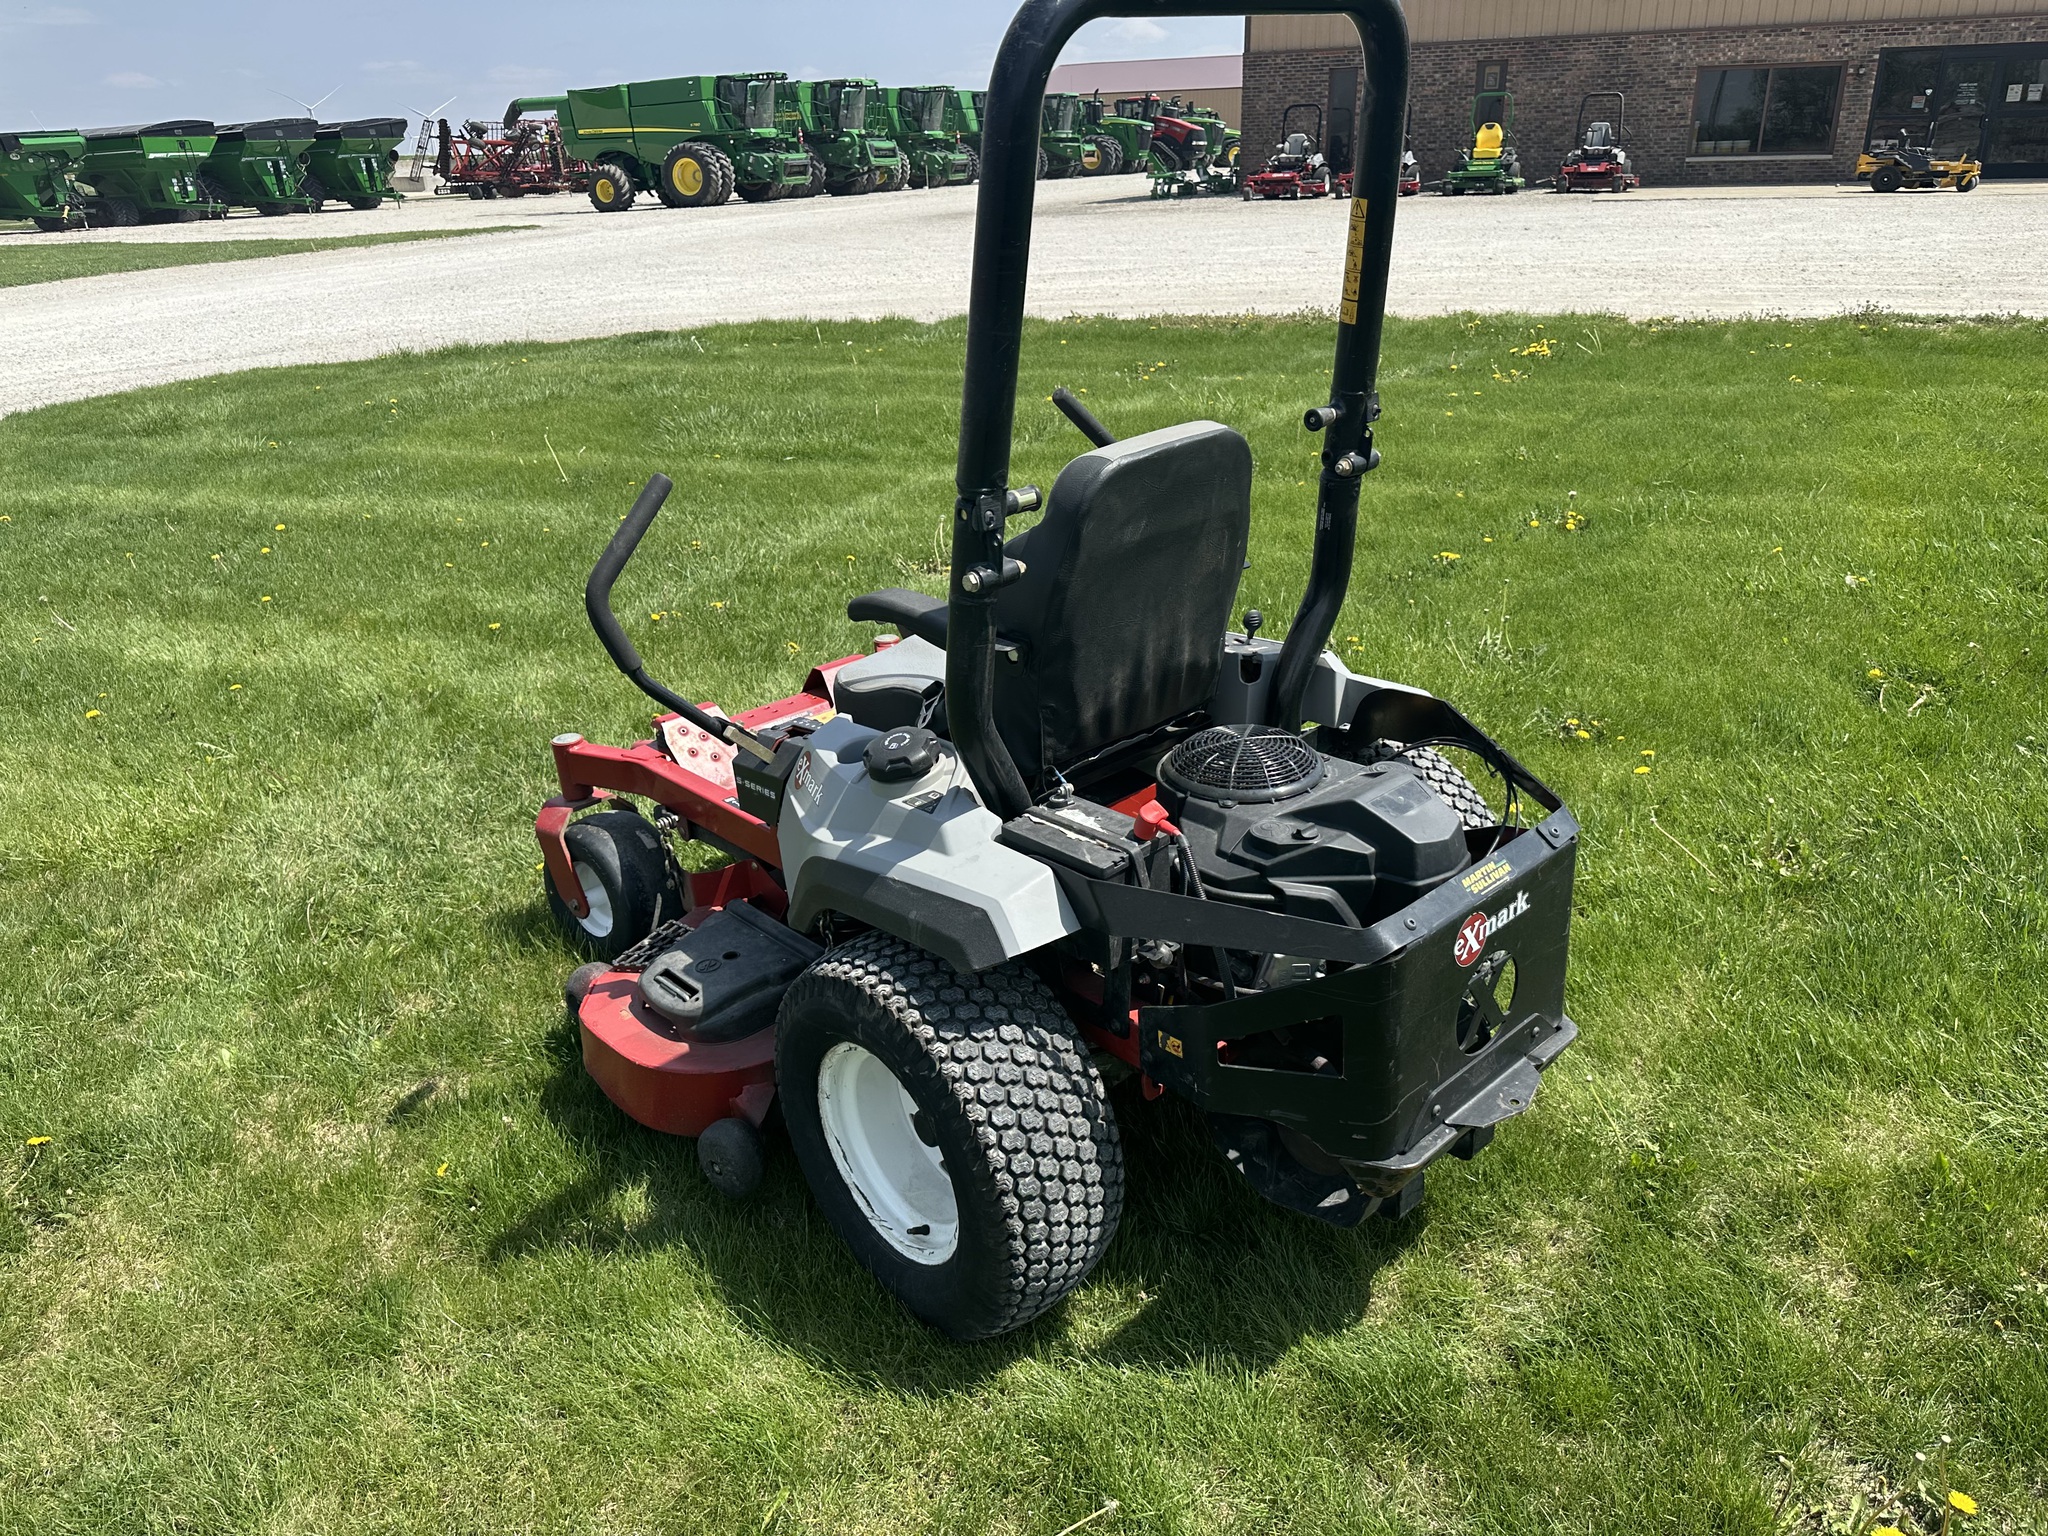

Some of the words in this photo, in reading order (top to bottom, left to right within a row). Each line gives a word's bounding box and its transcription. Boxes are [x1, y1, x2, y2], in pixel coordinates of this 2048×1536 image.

[1462, 861, 1496, 888] MARTIN
[1471, 863, 1512, 894] SULLIVAN
[1454, 890, 1531, 961] eXmark
